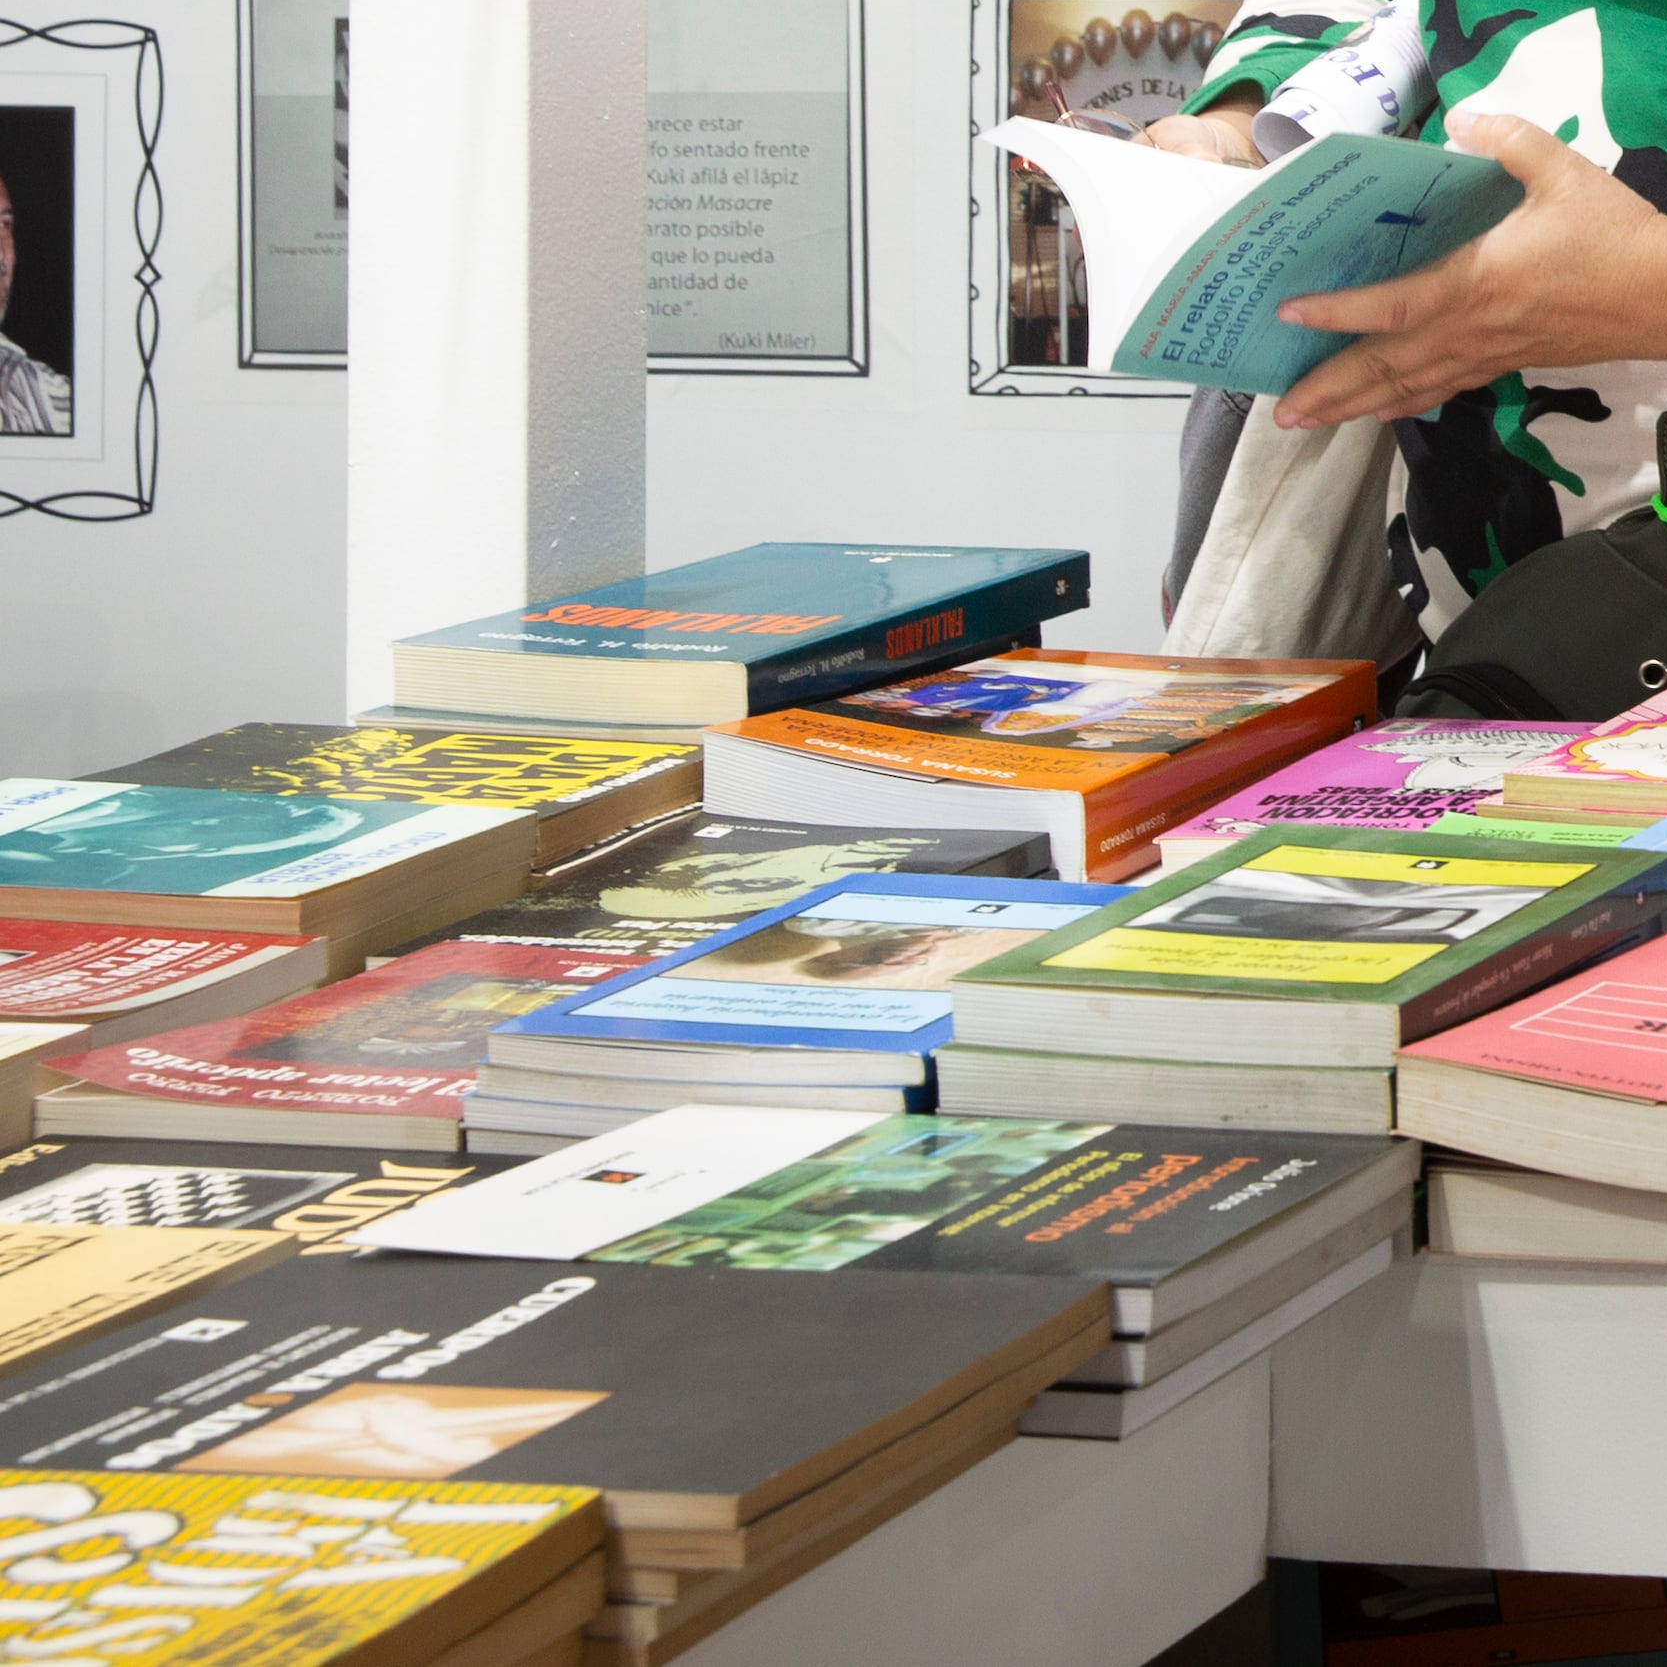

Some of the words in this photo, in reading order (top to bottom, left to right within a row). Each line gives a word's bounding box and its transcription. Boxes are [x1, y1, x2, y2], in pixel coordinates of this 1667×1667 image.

[1141, 78, 1162, 95] DE
[1169, 81, 1186, 99] LA
[699, 117, 743, 133] estar
[673, 143, 749, 159] sentado
[754, 142, 811, 159] frente
[733, 168, 750, 185] el
[754, 168, 800, 189] lápiz
[696, 194, 773, 211] Masacre
[696, 220, 765, 240] posible
[652, 248, 688, 269] que
[692, 247, 710, 264] lo
[714, 247, 775, 269] pueda
[1161, 339, 1187, 362] El
[1181, 271, 1229, 334] relato
[1227, 240, 1254, 267] de
[1249, 209, 1286, 237] los
[1281, 151, 1362, 208] hechos
[724, 274, 749, 291] de
[1210, 261, 1285, 369] testimonio
[1282, 244, 1299, 261] y
[1297, 175, 1381, 241] escritura
[1186, 284, 1245, 366] Rodolfo
[519, 603, 843, 634] FALKLANDS
[885, 607, 964, 660] FALKLANDS
[831, 647, 865, 671] Rodolfo
[777, 663, 816, 683] Terragno
[804, 738, 914, 764] TORRADO
[919, 759, 1018, 780] SUSANA
[1256, 795, 1438, 806] ARGENTINA
[124, 1047, 310, 1081] apócrifo
[125, 1072, 243, 1096] FERRO
[306, 1073, 445, 1095] lector
[249, 1089, 408, 1107] ROBERTO
